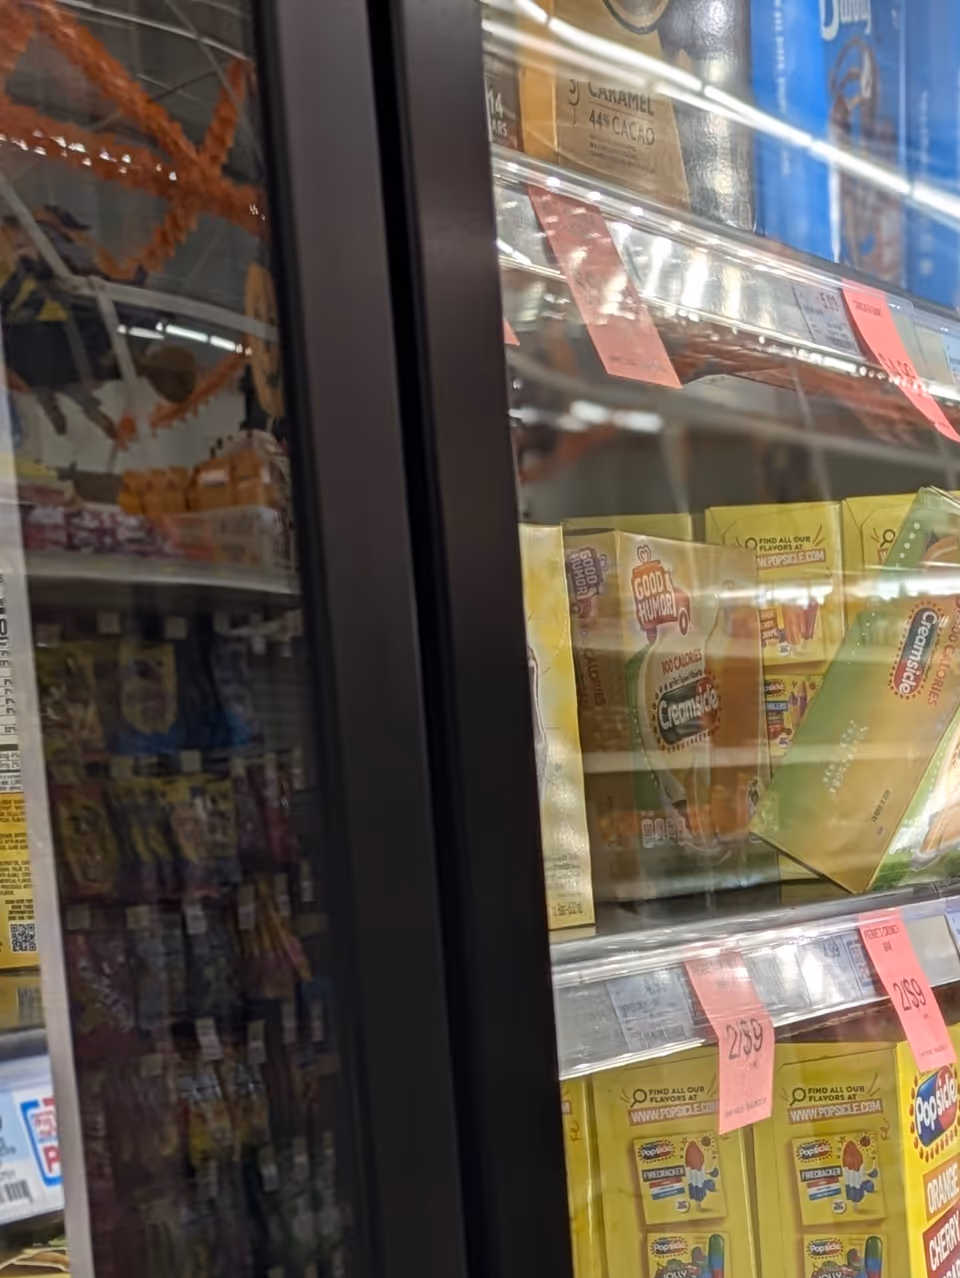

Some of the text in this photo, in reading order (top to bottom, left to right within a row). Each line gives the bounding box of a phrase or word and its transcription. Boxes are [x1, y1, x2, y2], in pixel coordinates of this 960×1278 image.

[588, 81, 655, 116] CARAMEL
[611, 115, 655, 146] CACAO
[779, 536, 792, 544] ALL
[569, 553, 588, 599] HUMOR
[580, 548, 598, 585] GOOD
[634, 570, 664, 600] GOOD
[638, 594, 673, 622] HUMOR
[674, 648, 703, 672] CALORIES
[898, 609, 938, 695] Creamsicle
[927, 642, 956, 707] CALORIES
[659, 684, 719, 730] Creamsicle
[726, 1018, 765, 1061] 2/$9
[650, 1095, 686, 1103] FLAVORS
[671, 1087, 685, 1095] ALL
[687, 1086, 705, 1094] OUR
[808, 1094, 845, 1102] FLAVORS
[916, 1077, 957, 1133] Popsicle
[790, 1099, 881, 1123] WWW.POPSICLE.COM
[642, 1166, 685, 1180] FIRECRACKER
[801, 1167, 841, 1181] FIRECRACKER
[927, 1163, 960, 1214] ORANGE
[928, 1210, 960, 1272] CHERRY
